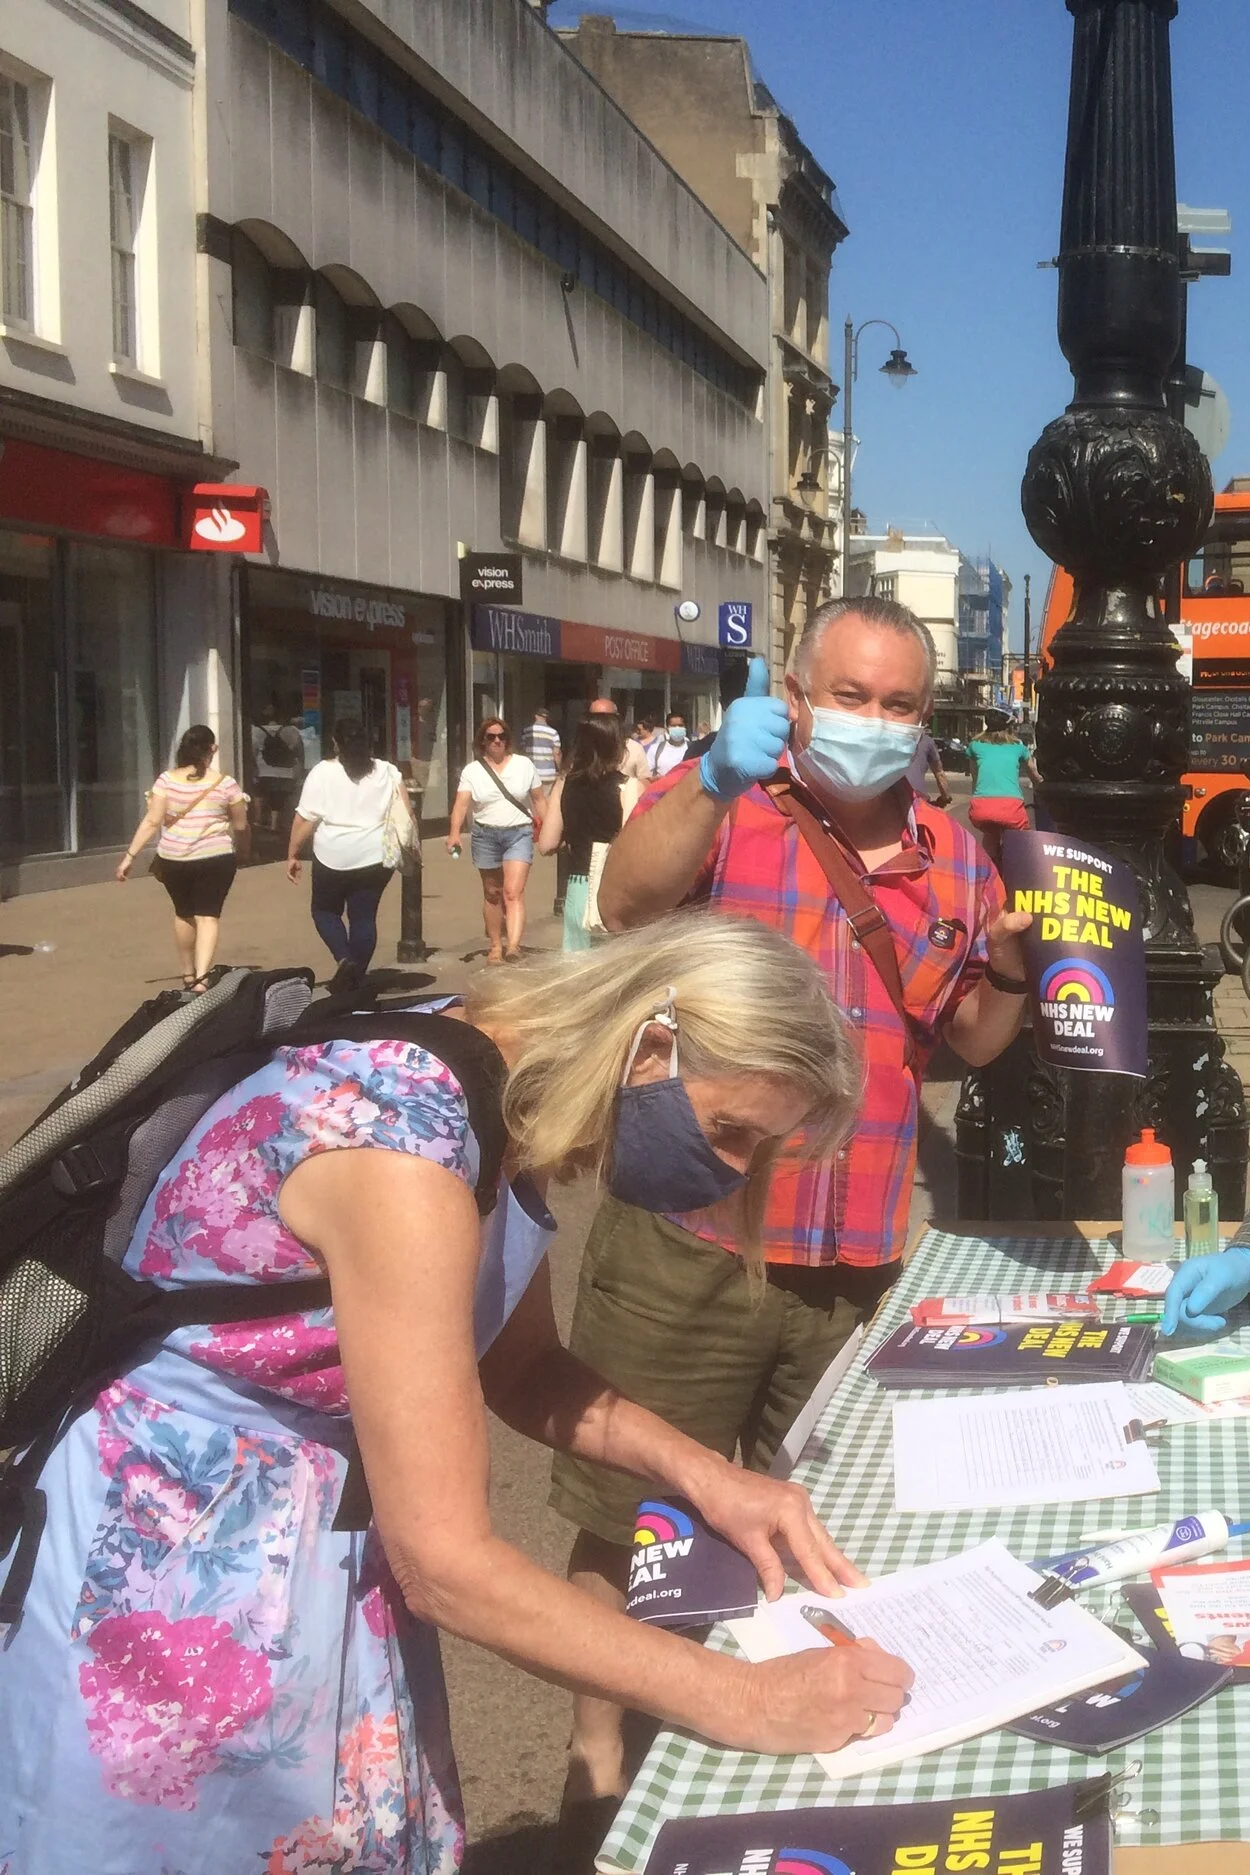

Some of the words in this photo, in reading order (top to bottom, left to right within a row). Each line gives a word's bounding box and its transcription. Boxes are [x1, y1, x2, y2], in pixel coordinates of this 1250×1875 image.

[478, 566, 509, 577] vision
[728, 605, 747, 615] WH
[488, 610, 552, 655] WHSmith
[727, 613, 748, 644] S
[605, 635, 624, 659] POST
[625, 638, 649, 662] OFFICE
[1192, 733, 1203, 742] to
[1205, 733, 1229, 743] Park
[1221, 755, 1237, 766] 30
[1043, 845, 1065, 858] WE
[1066, 847, 1113, 874] SUPPORT
[1052, 866, 1104, 897] THE
[1015, 890, 1071, 915] NHS
[1076, 895, 1132, 931] NEW
[1042, 917, 1113, 949] DEAL
[1040, 1002, 1069, 1019] NHS
[1069, 1004, 1114, 1023] NEW
[1054, 1020, 1095, 1038] DEAL
[919, 1329, 945, 1344] DEAL
[1017, 1328, 1043, 1350] DEAL
[1042, 1337, 1076, 1358] NEW
[1077, 1330, 1108, 1349] THE
[630, 1537, 694, 1573] NEW
[944, 1809, 995, 1872] NHS
[1062, 1824, 1084, 1849] WE
